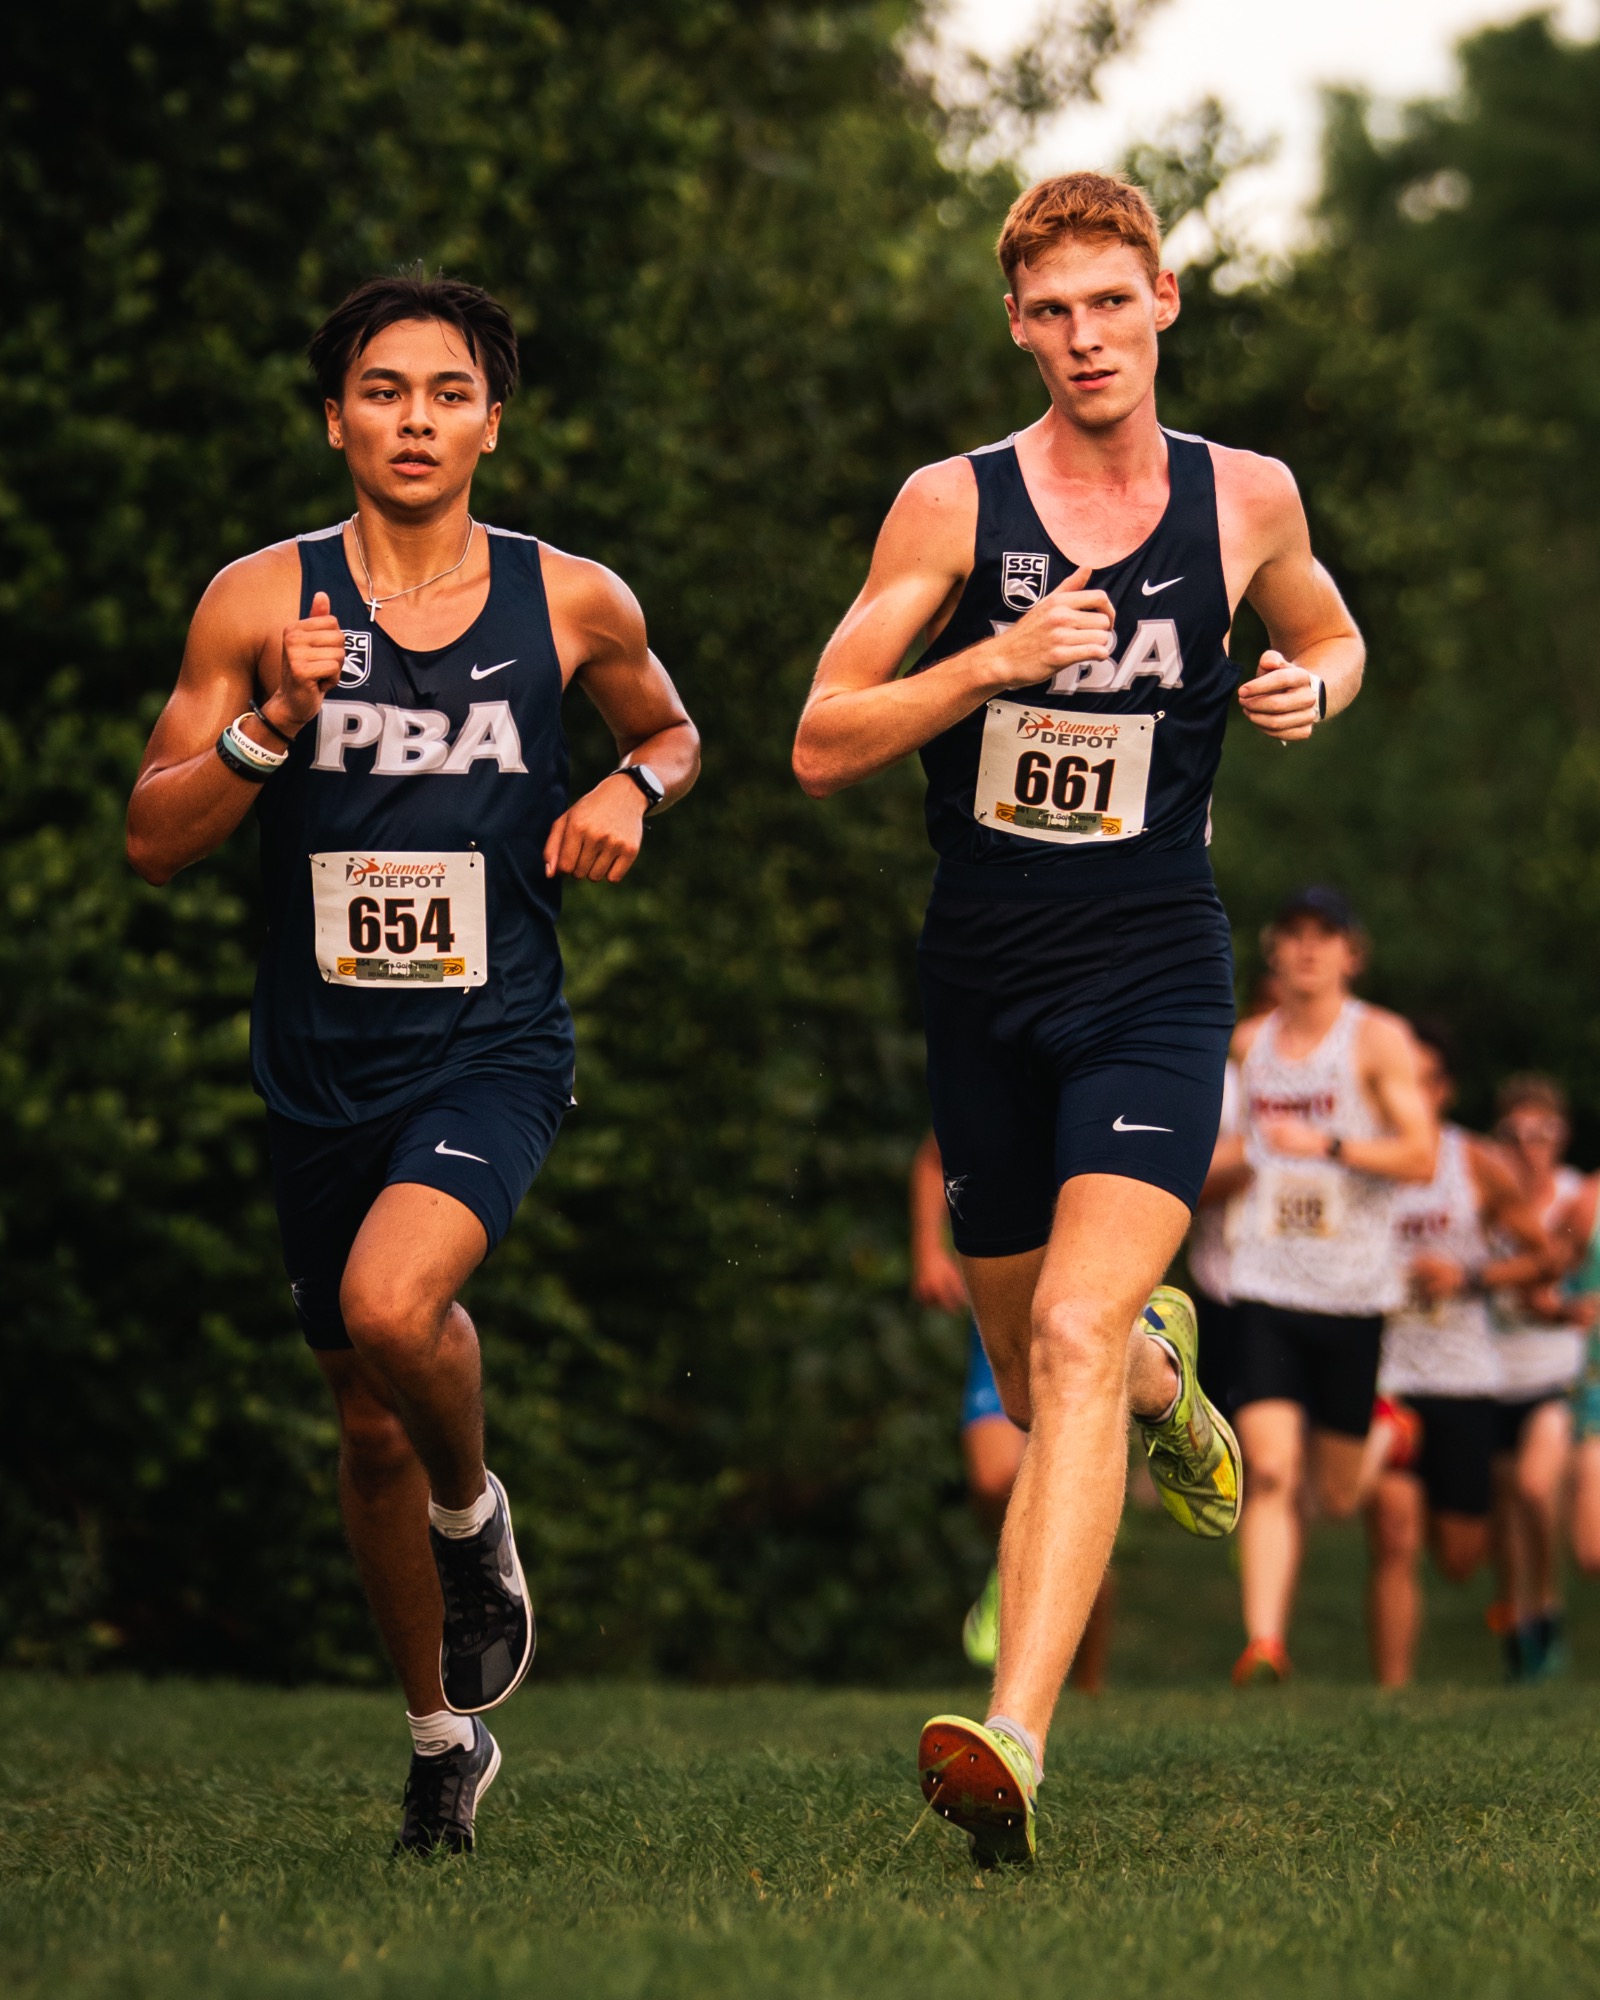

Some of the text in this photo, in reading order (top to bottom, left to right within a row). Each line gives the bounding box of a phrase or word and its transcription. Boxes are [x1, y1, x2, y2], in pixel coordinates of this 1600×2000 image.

[1008, 558, 1044, 572] SSC
[344, 635, 367, 649] SC
[989, 619, 1184, 696] BA
[1053, 720, 1121, 736] Runner's
[309, 699, 529, 775] PBA
[1041, 731, 1118, 749] DEPOT
[1014, 750, 1116, 812] 661
[381, 862, 447, 875] Runner's
[369, 875, 446, 888] DEPOT
[348, 896, 455, 954] 654
